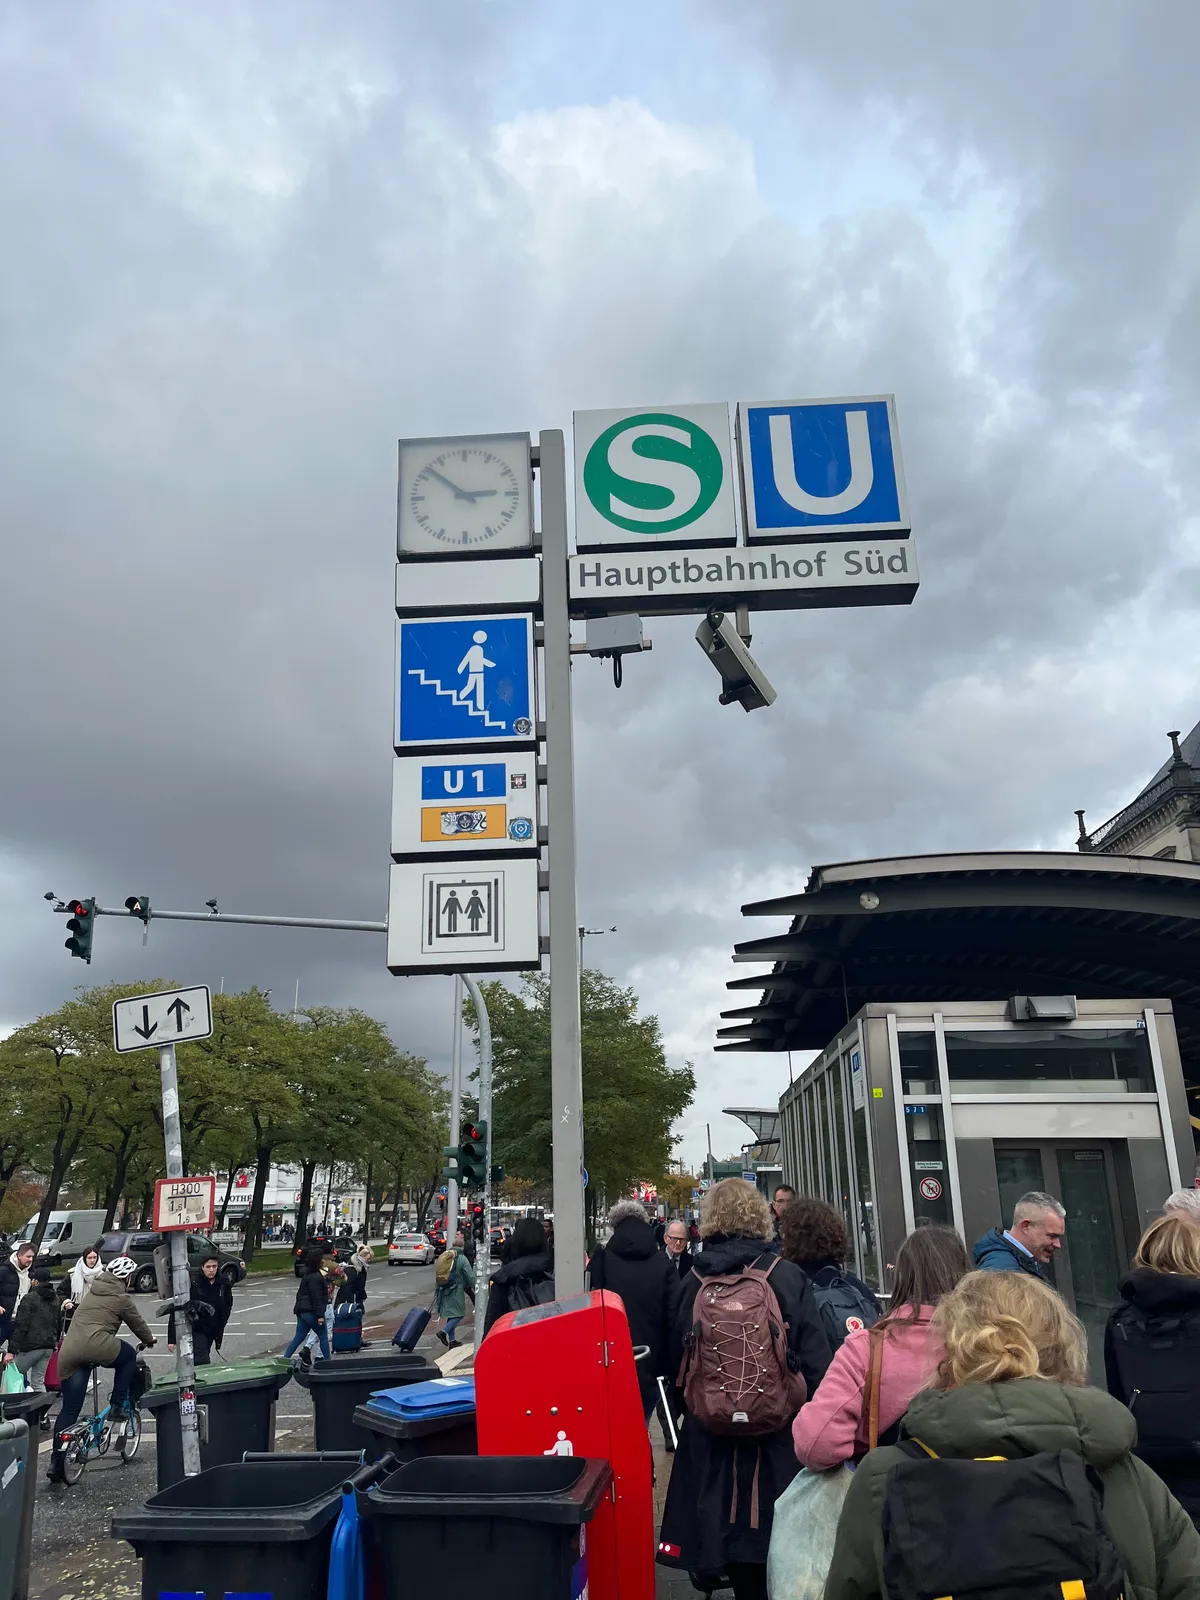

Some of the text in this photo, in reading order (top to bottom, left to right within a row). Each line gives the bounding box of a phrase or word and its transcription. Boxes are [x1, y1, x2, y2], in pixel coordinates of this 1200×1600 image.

[607, 423, 702, 523] S
[768, 410, 874, 516] U
[579, 547, 909, 591] Hauptbahnhof Süd
[171, 1183, 201, 1196] H300
